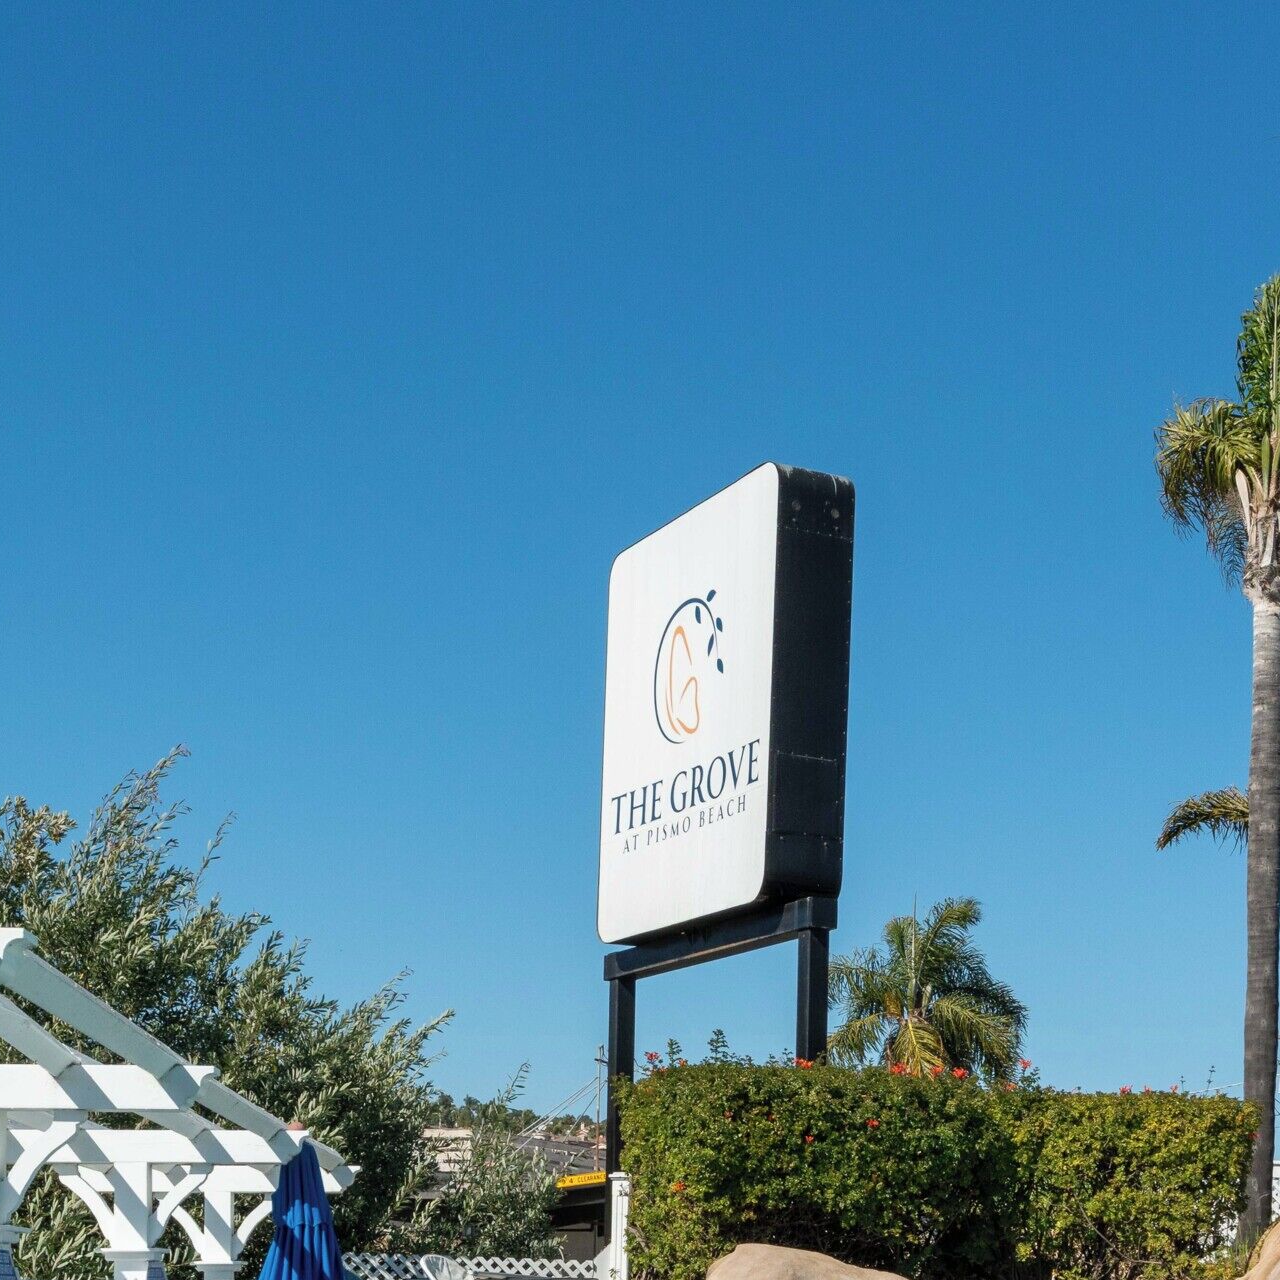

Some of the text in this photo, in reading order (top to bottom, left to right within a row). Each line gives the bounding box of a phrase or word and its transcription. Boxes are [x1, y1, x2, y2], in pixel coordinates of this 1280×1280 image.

[611, 739, 761, 836] THE GROVE
[622, 794, 747, 855] AT PISMO BEACH
